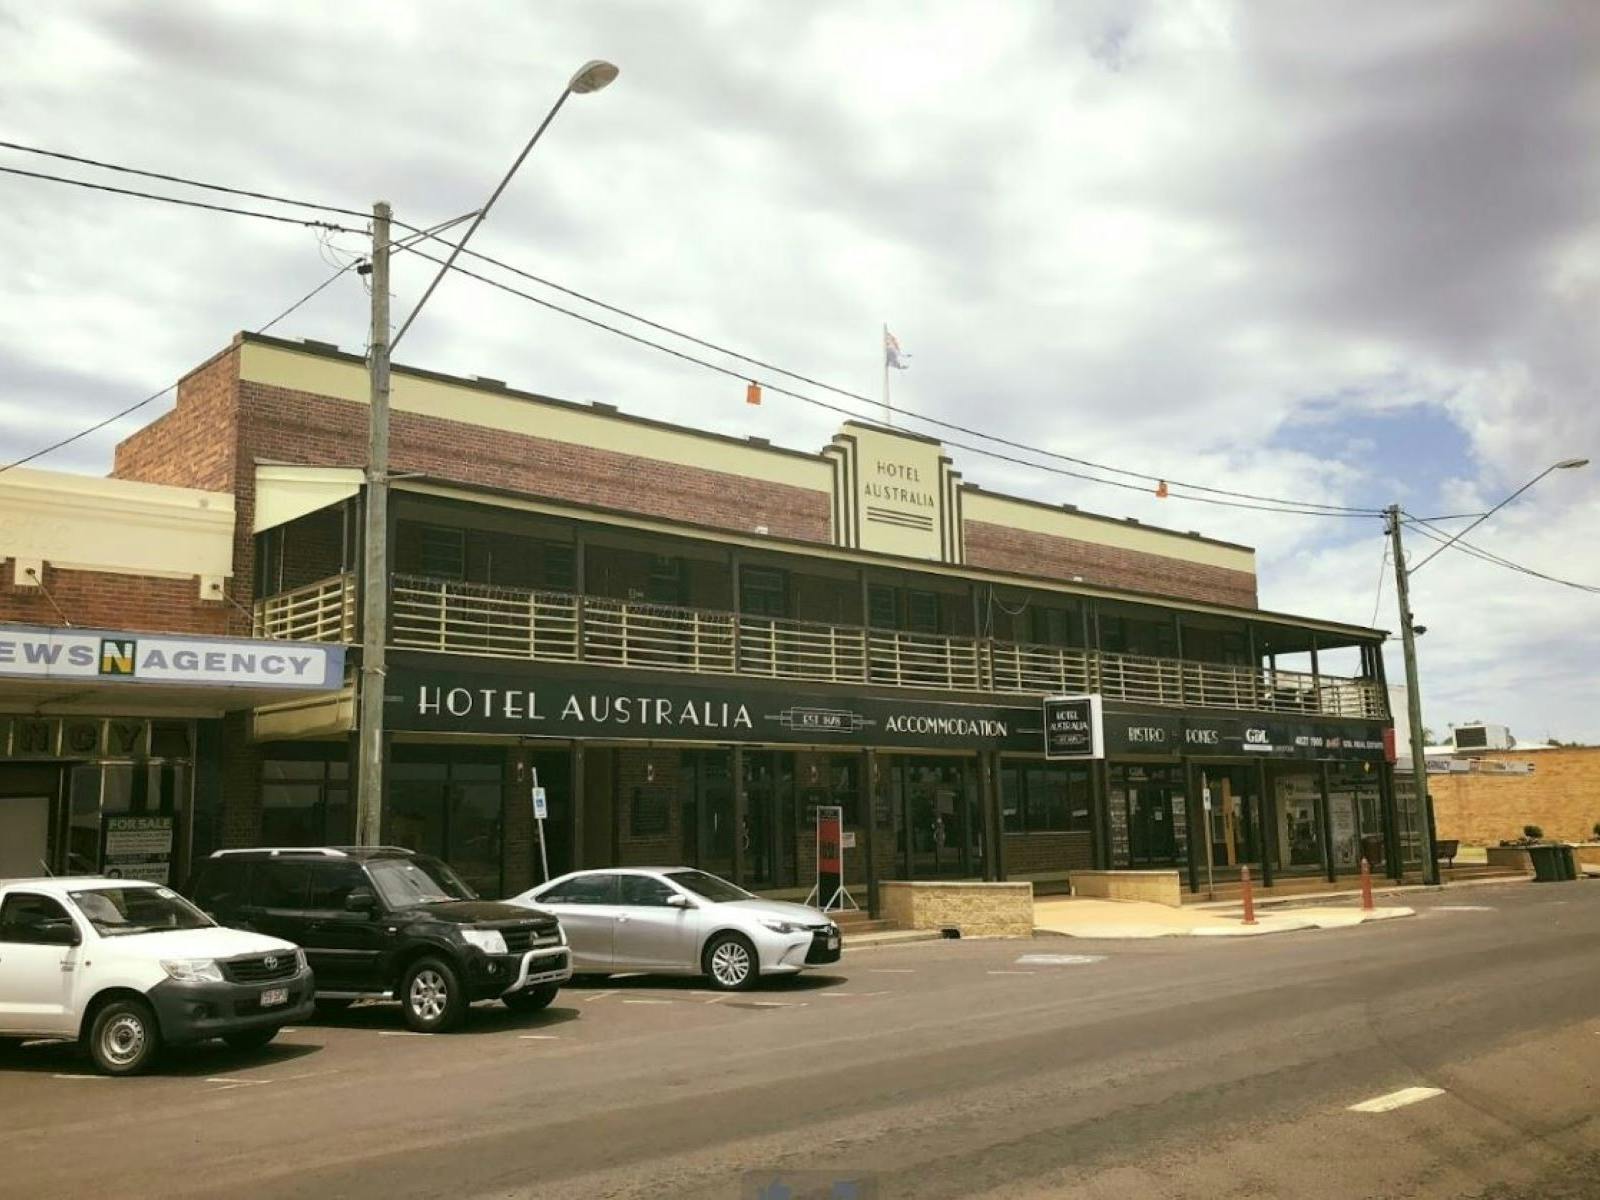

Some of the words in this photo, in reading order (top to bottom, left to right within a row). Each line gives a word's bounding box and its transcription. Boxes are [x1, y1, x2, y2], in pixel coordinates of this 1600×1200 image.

[877, 461, 920, 482] HOTEL
[864, 482, 934, 508] AUSTRALIA
[142, 650, 312, 675] AGENCY
[418, 686, 545, 719] HOTEL
[561, 695, 753, 728] AUSTRALIA
[885, 715, 1008, 737] ACCOMMODATION
[1128, 727, 1166, 742] BISTRO
